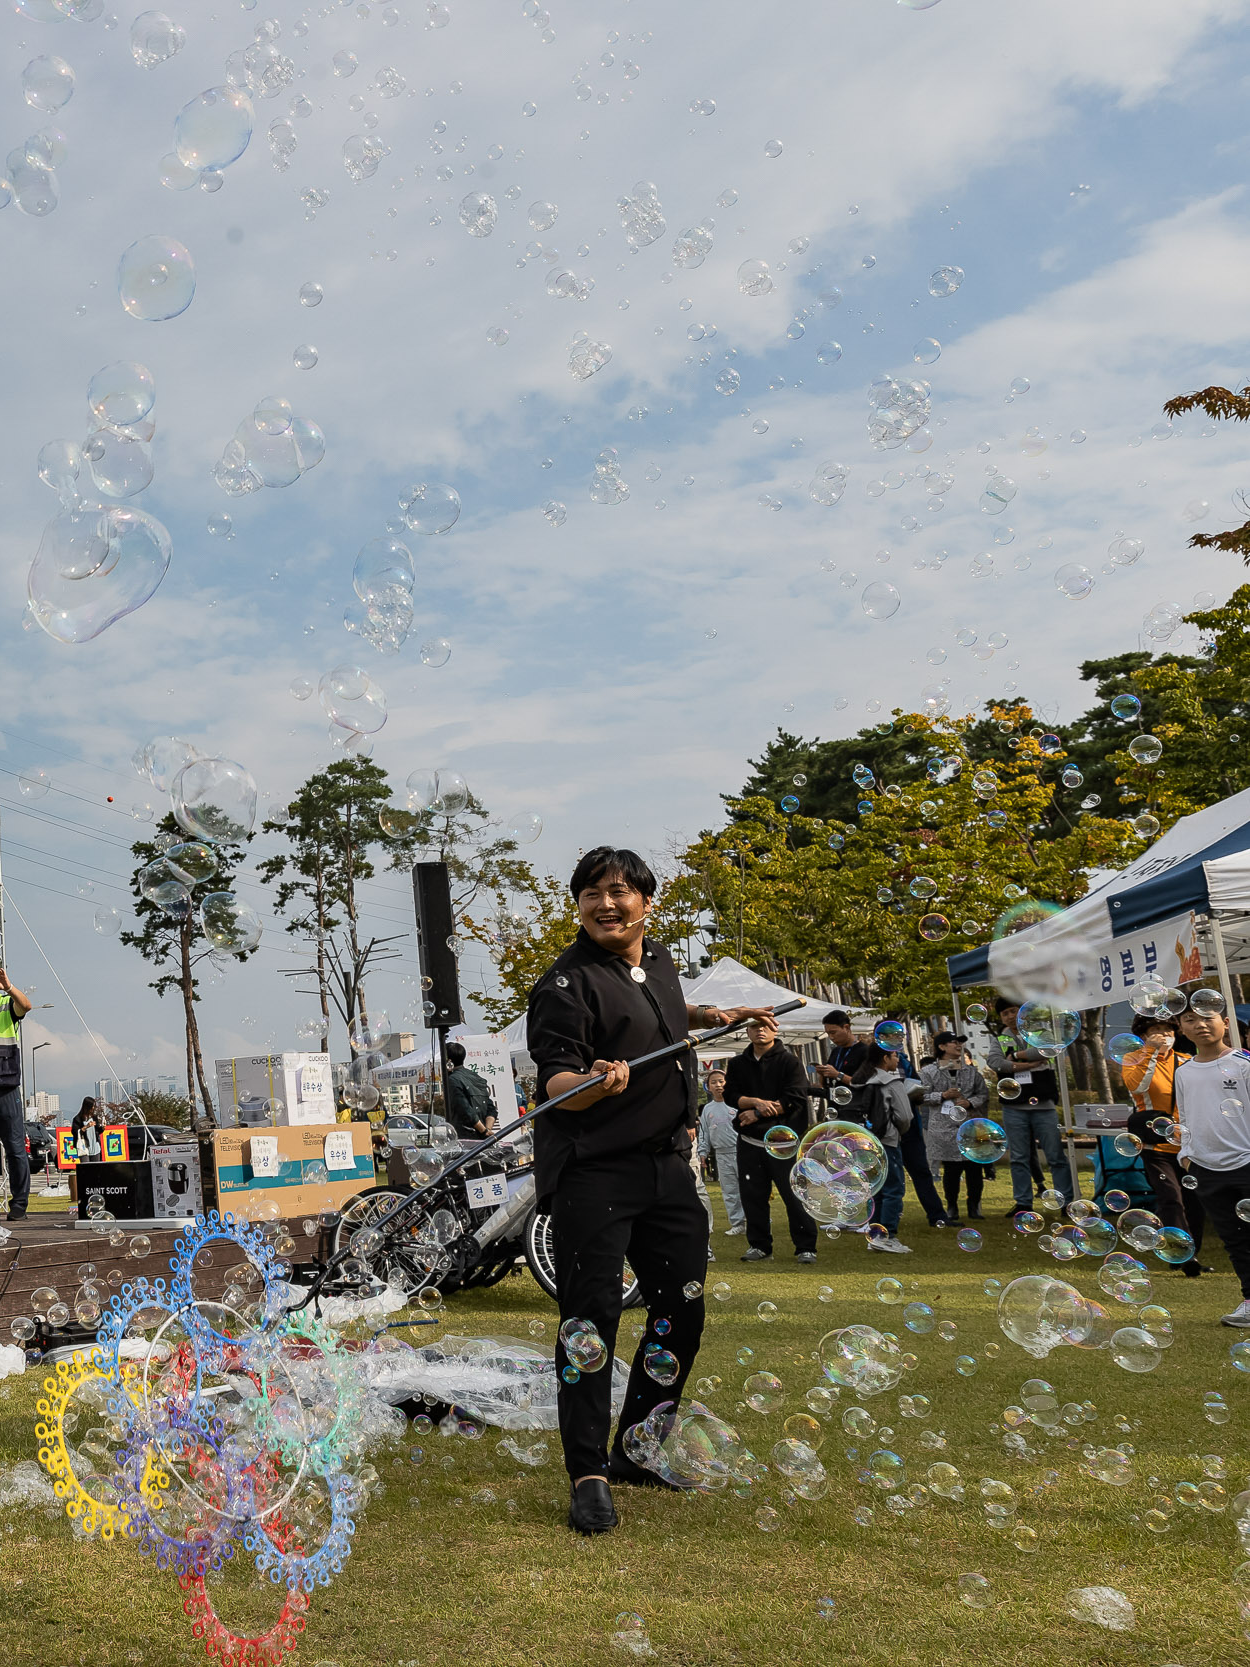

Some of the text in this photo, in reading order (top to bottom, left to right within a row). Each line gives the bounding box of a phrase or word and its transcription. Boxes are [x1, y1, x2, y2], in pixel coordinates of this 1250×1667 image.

[1078, 941, 1158, 992] 영본부
[251, 1054, 282, 1066] CUCKOO
[85, 1187, 105, 1195] SAINT
